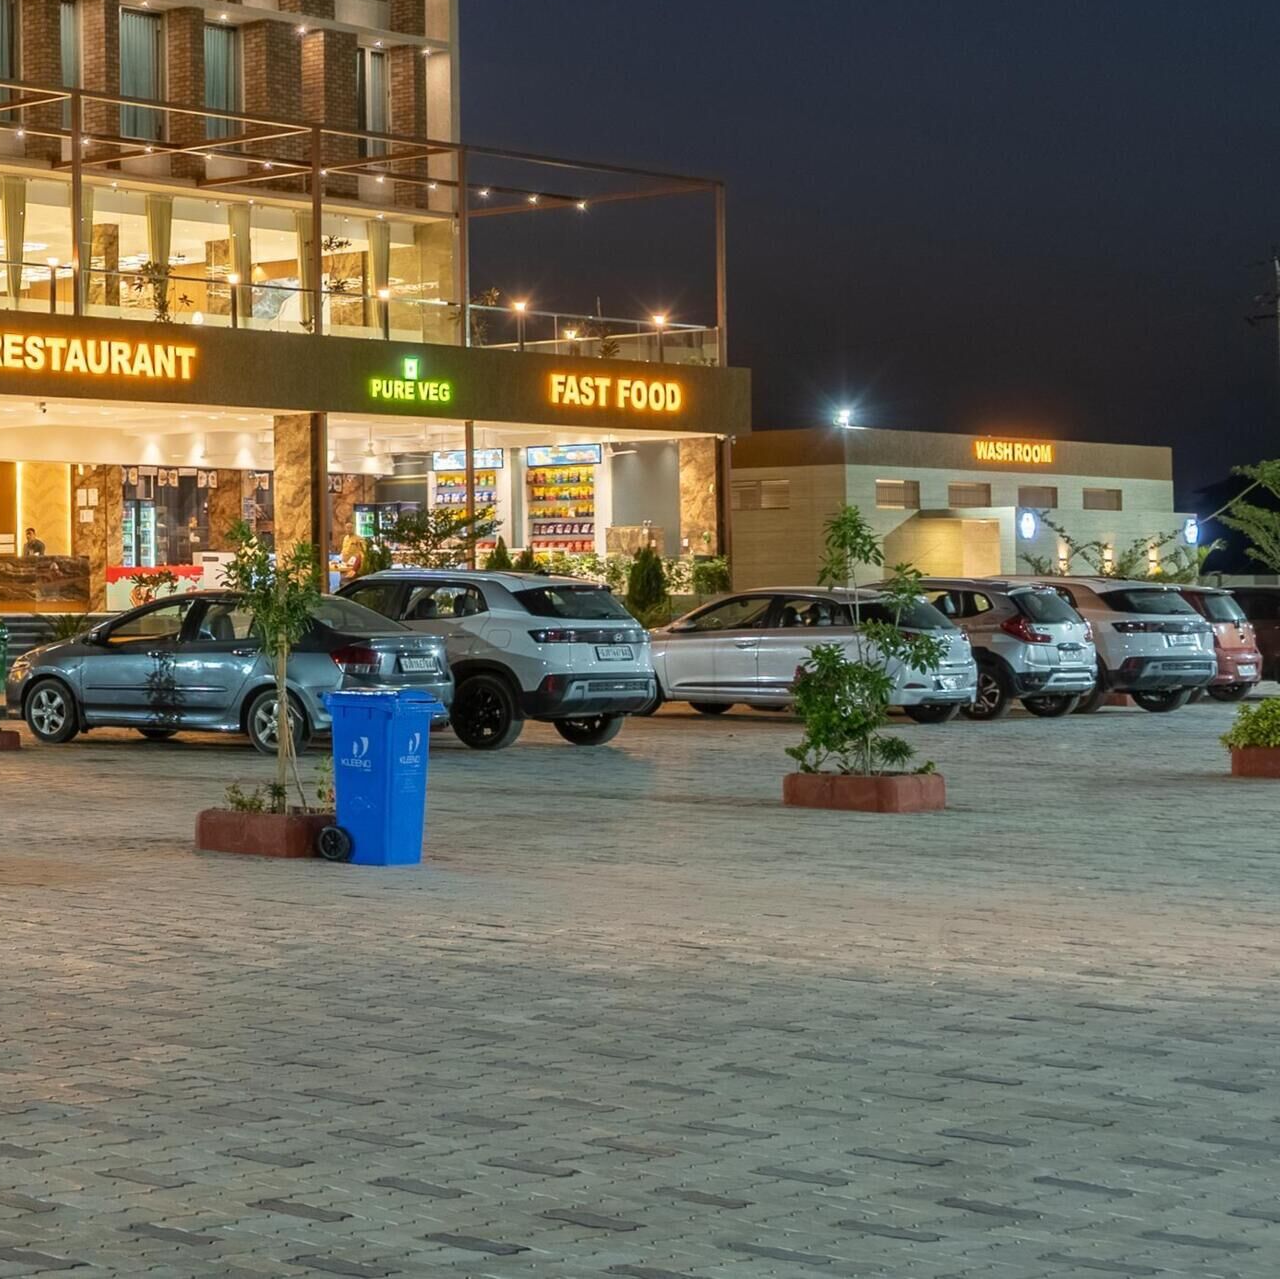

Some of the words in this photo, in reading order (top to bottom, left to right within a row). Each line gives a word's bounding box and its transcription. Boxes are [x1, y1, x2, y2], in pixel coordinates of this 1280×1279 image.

[371, 379, 416, 400] PURE
[418, 381, 451, 402] VEG
[550, 373, 611, 407] FAST
[616, 378, 682, 412] FOOD
[976, 440, 1013, 461] WASH
[1013, 442, 1052, 463] ROOM
